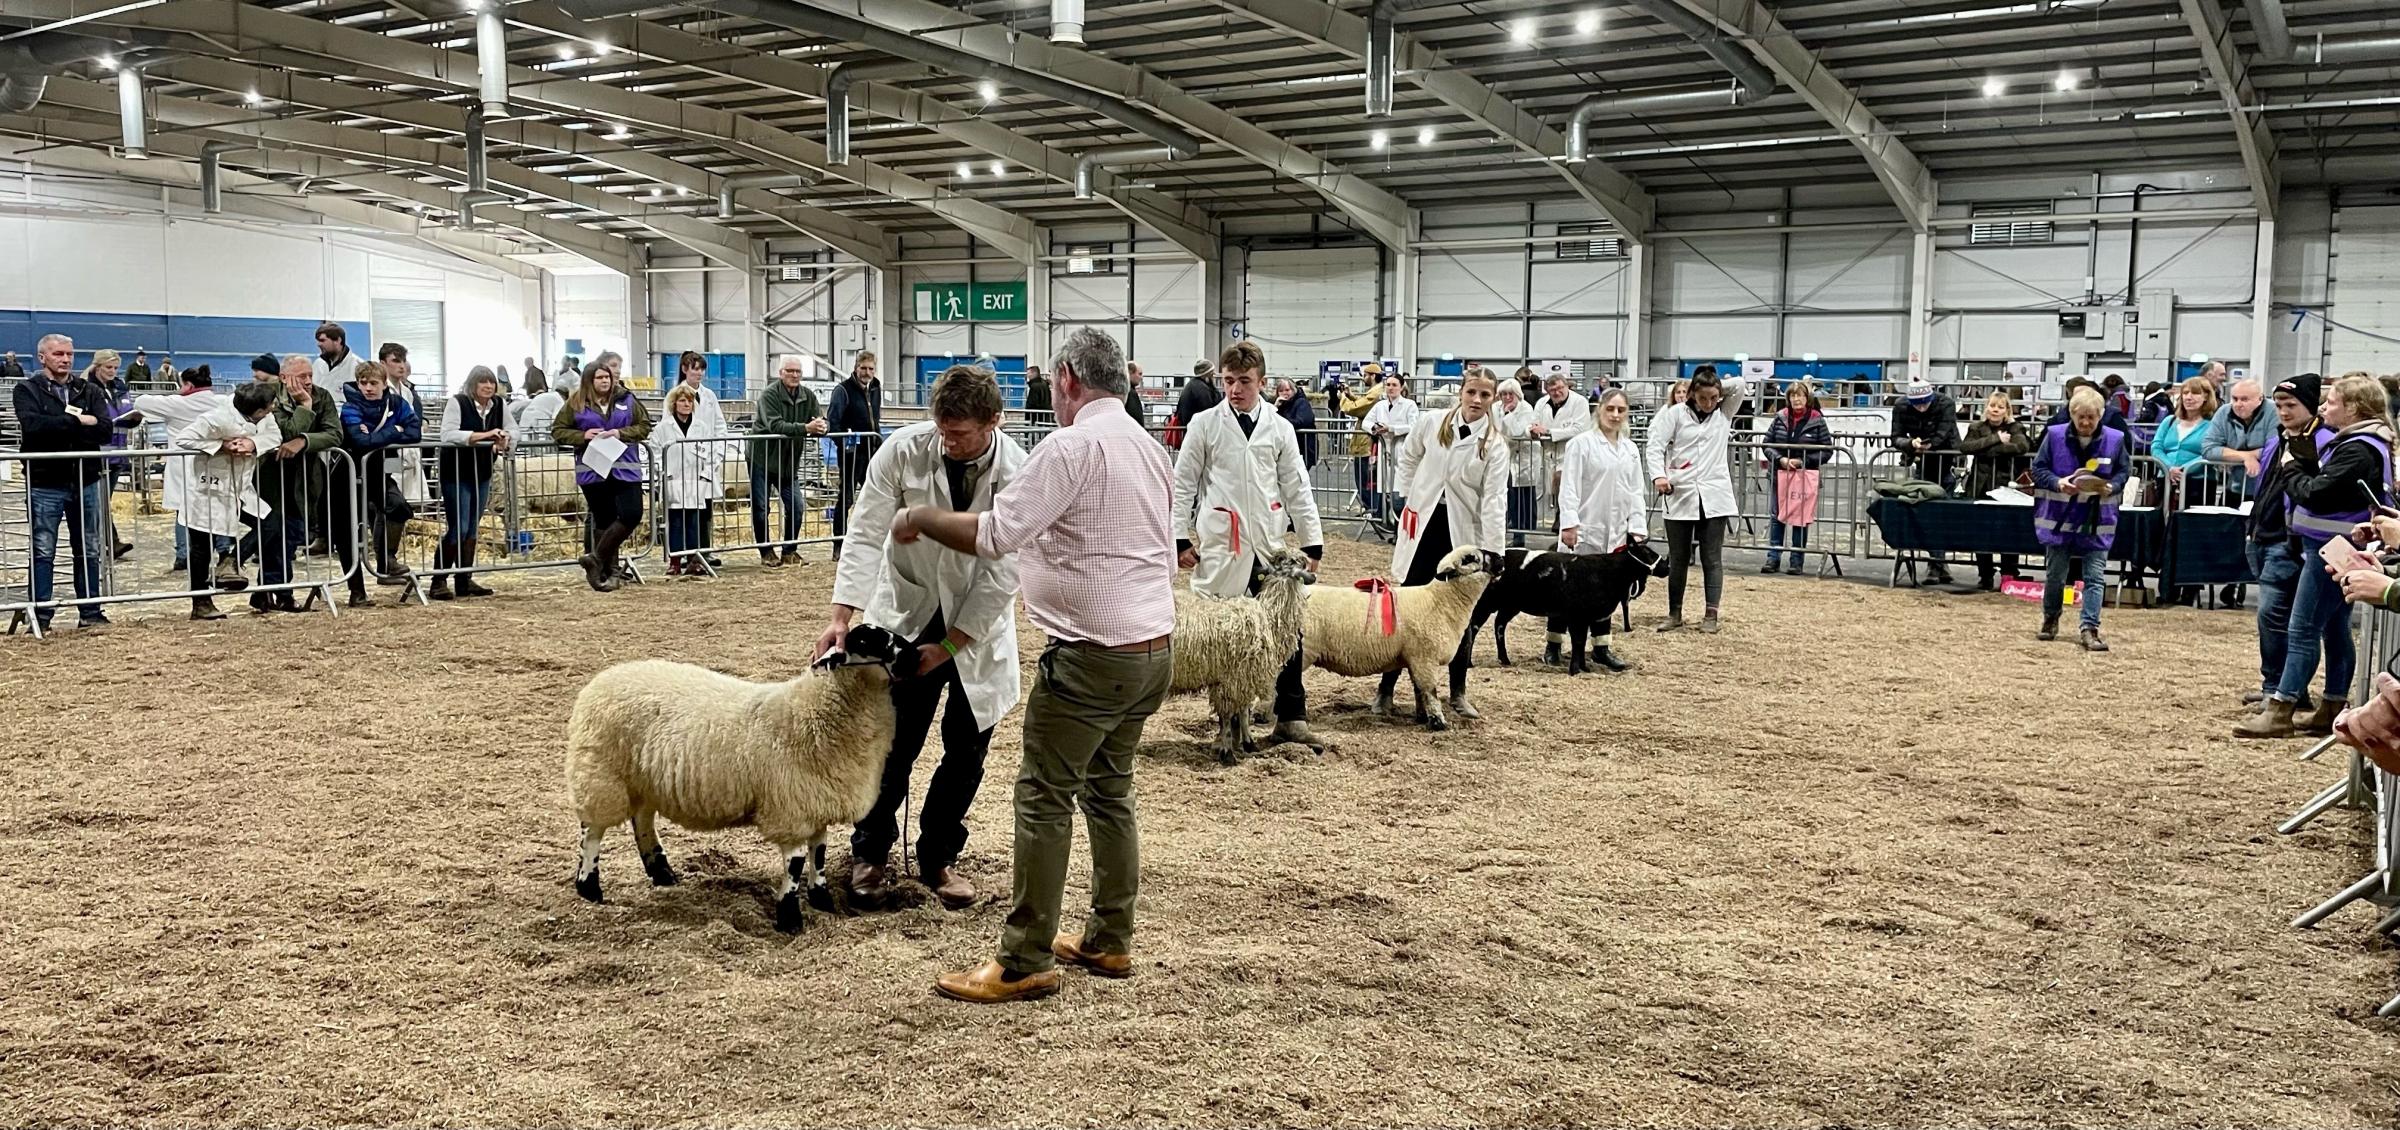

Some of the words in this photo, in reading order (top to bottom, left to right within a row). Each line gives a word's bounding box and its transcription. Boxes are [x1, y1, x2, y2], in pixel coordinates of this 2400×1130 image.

[983, 294, 1014, 310] EXIT
[2291, 310, 2306, 332] 7
[1232, 323, 1240, 338] 6
